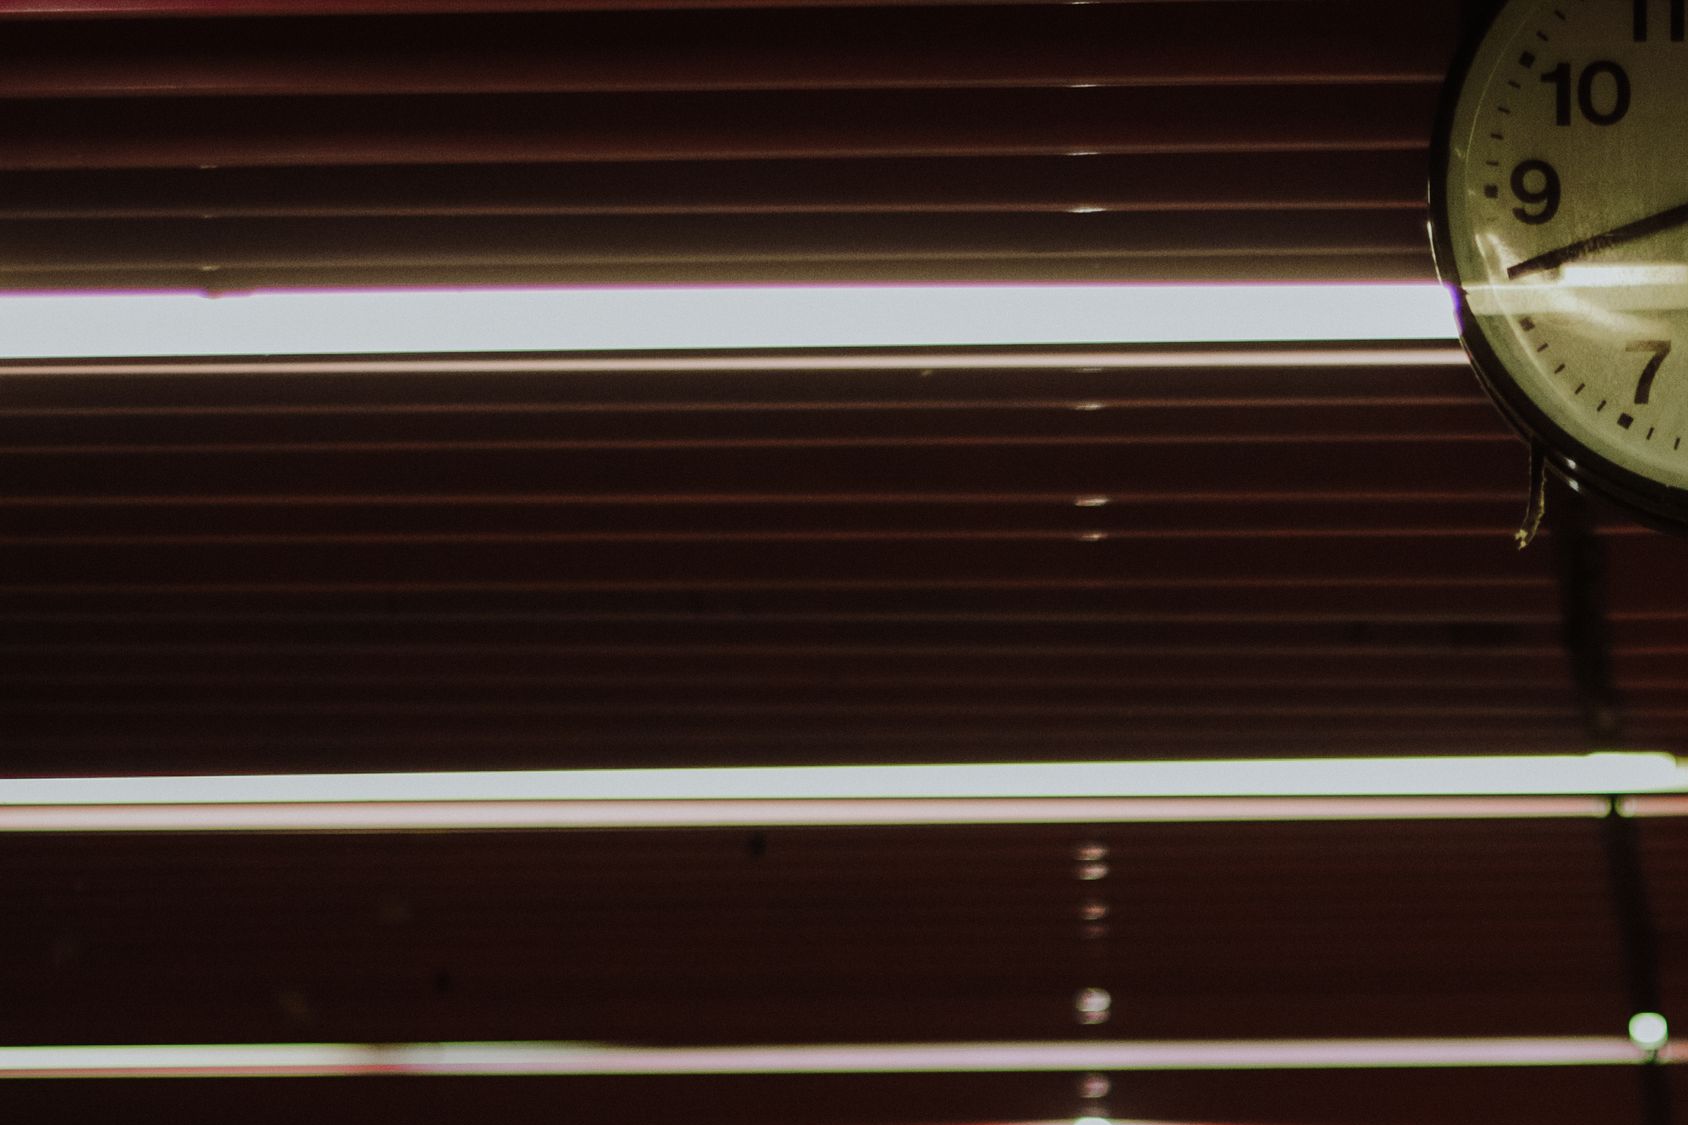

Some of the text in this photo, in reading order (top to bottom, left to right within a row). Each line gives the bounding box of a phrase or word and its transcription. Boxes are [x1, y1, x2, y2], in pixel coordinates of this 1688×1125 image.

[1540, 61, 1631, 126] 10
[1510, 160, 1561, 225] 9
[1625, 341, 1671, 404] 7
